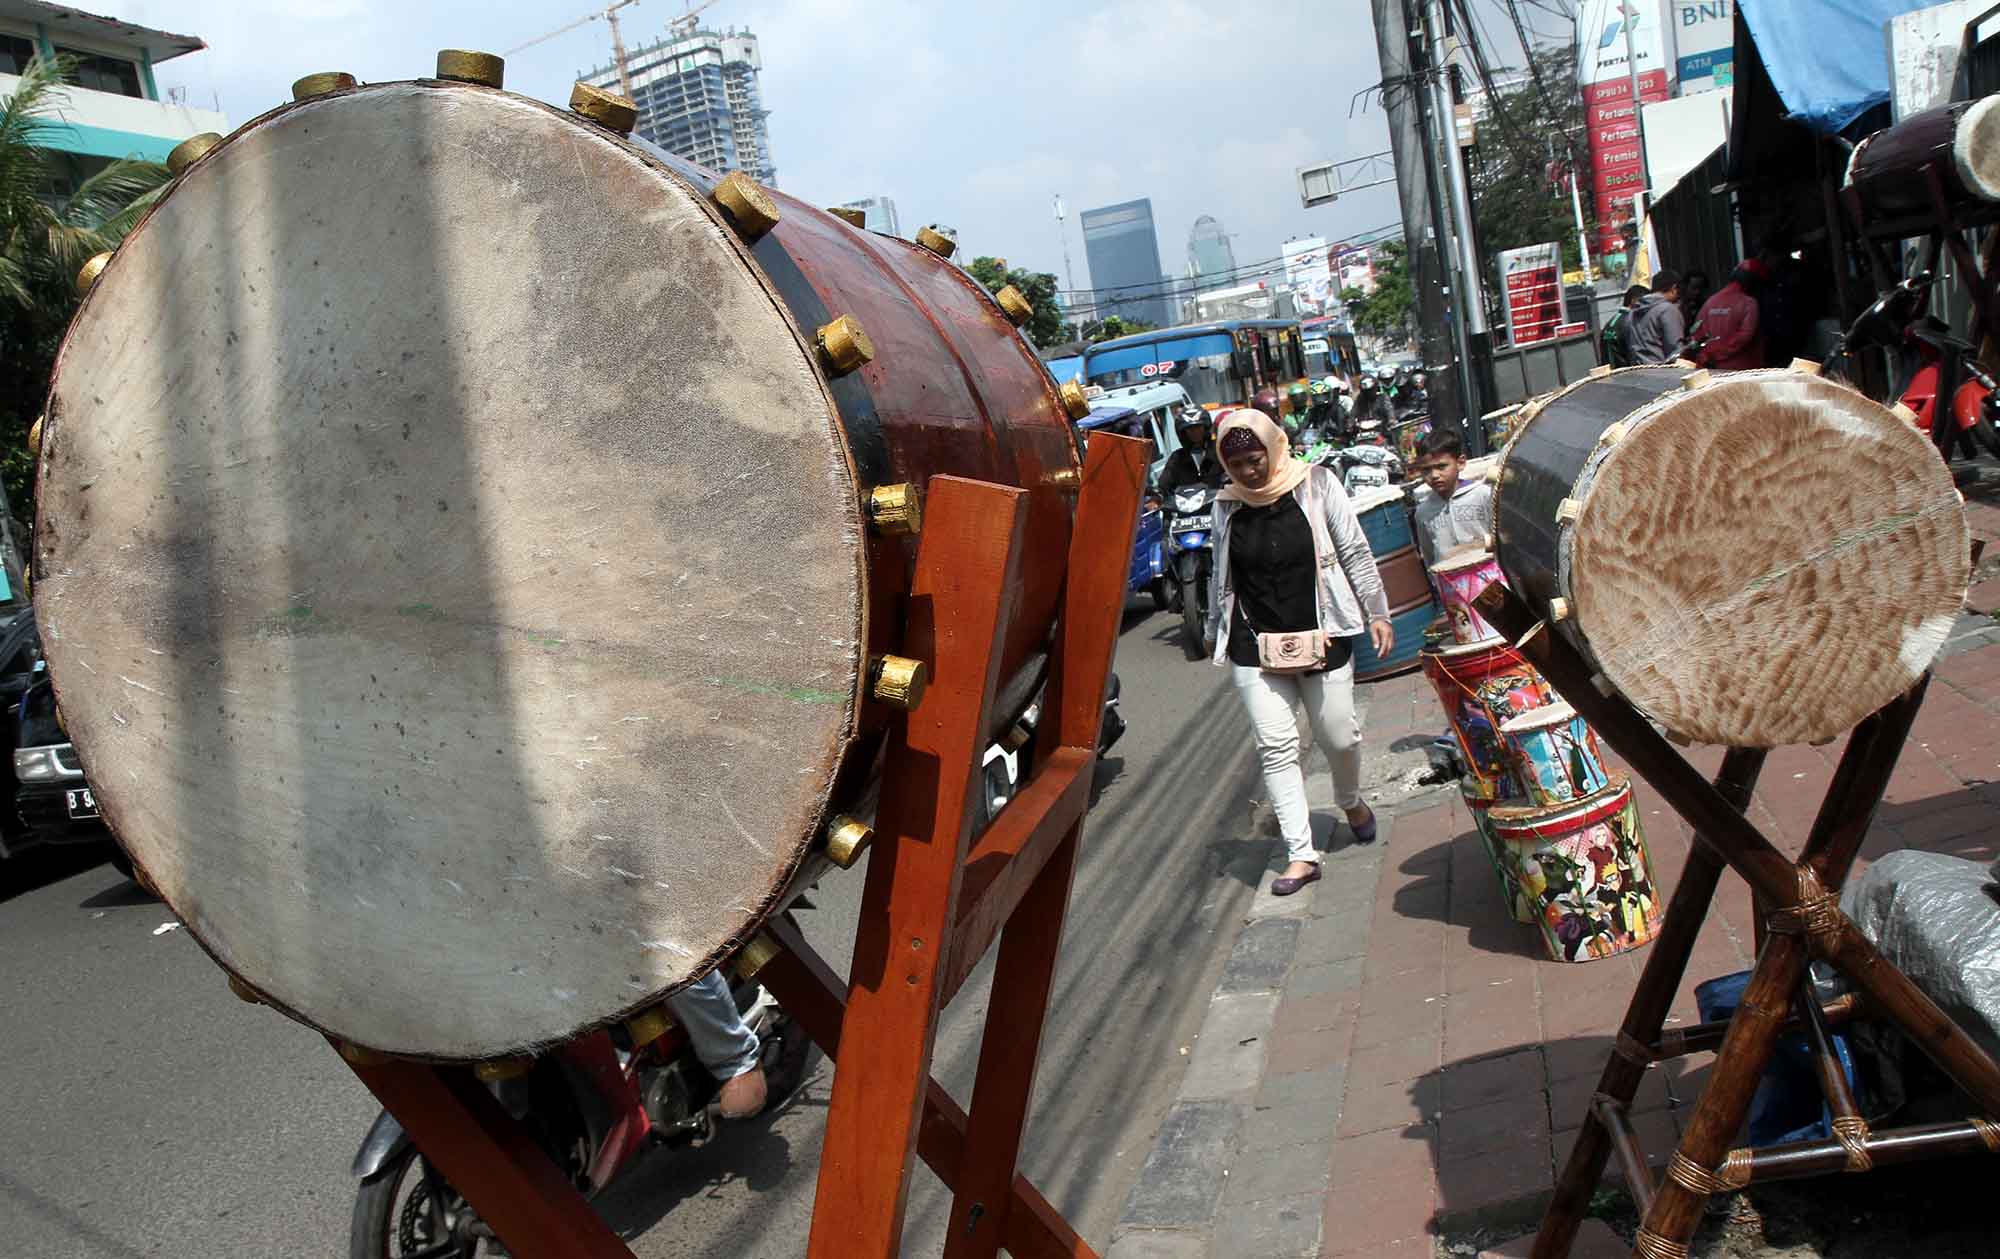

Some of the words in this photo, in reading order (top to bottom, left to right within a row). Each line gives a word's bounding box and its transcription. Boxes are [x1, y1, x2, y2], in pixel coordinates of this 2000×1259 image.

[1682, 0, 1727, 27] BNI
[1686, 57, 1712, 71] ATM
[69, 791, 77, 809] B
